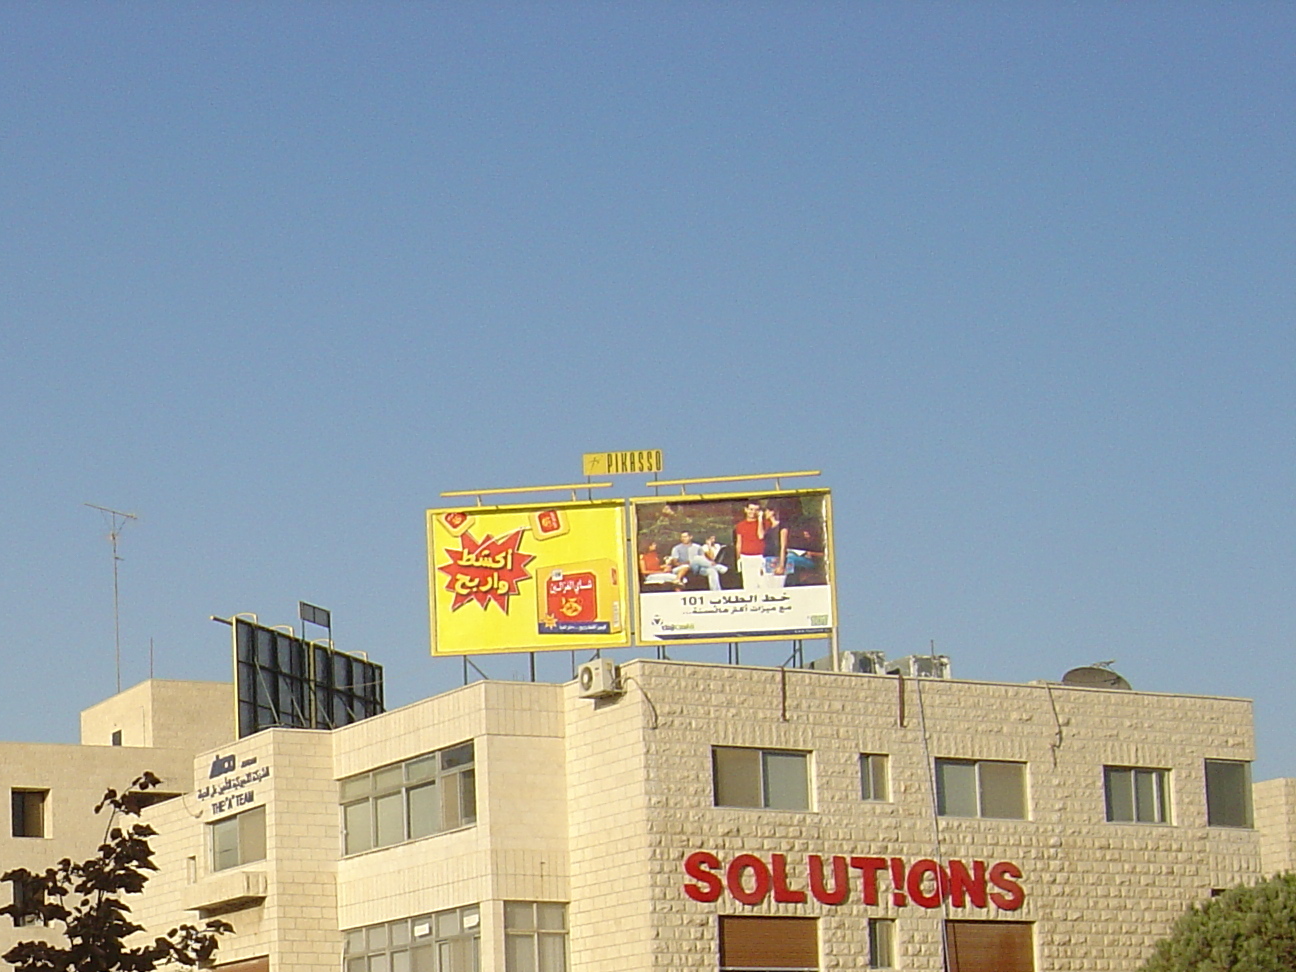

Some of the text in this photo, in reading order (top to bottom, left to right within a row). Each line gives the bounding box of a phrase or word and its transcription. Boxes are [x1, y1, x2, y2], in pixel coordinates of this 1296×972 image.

[607, 450, 661, 473] PIKASSO
[455, 571, 509, 595] واربح
[681, 592, 790, 606] خط الطلاب 101
